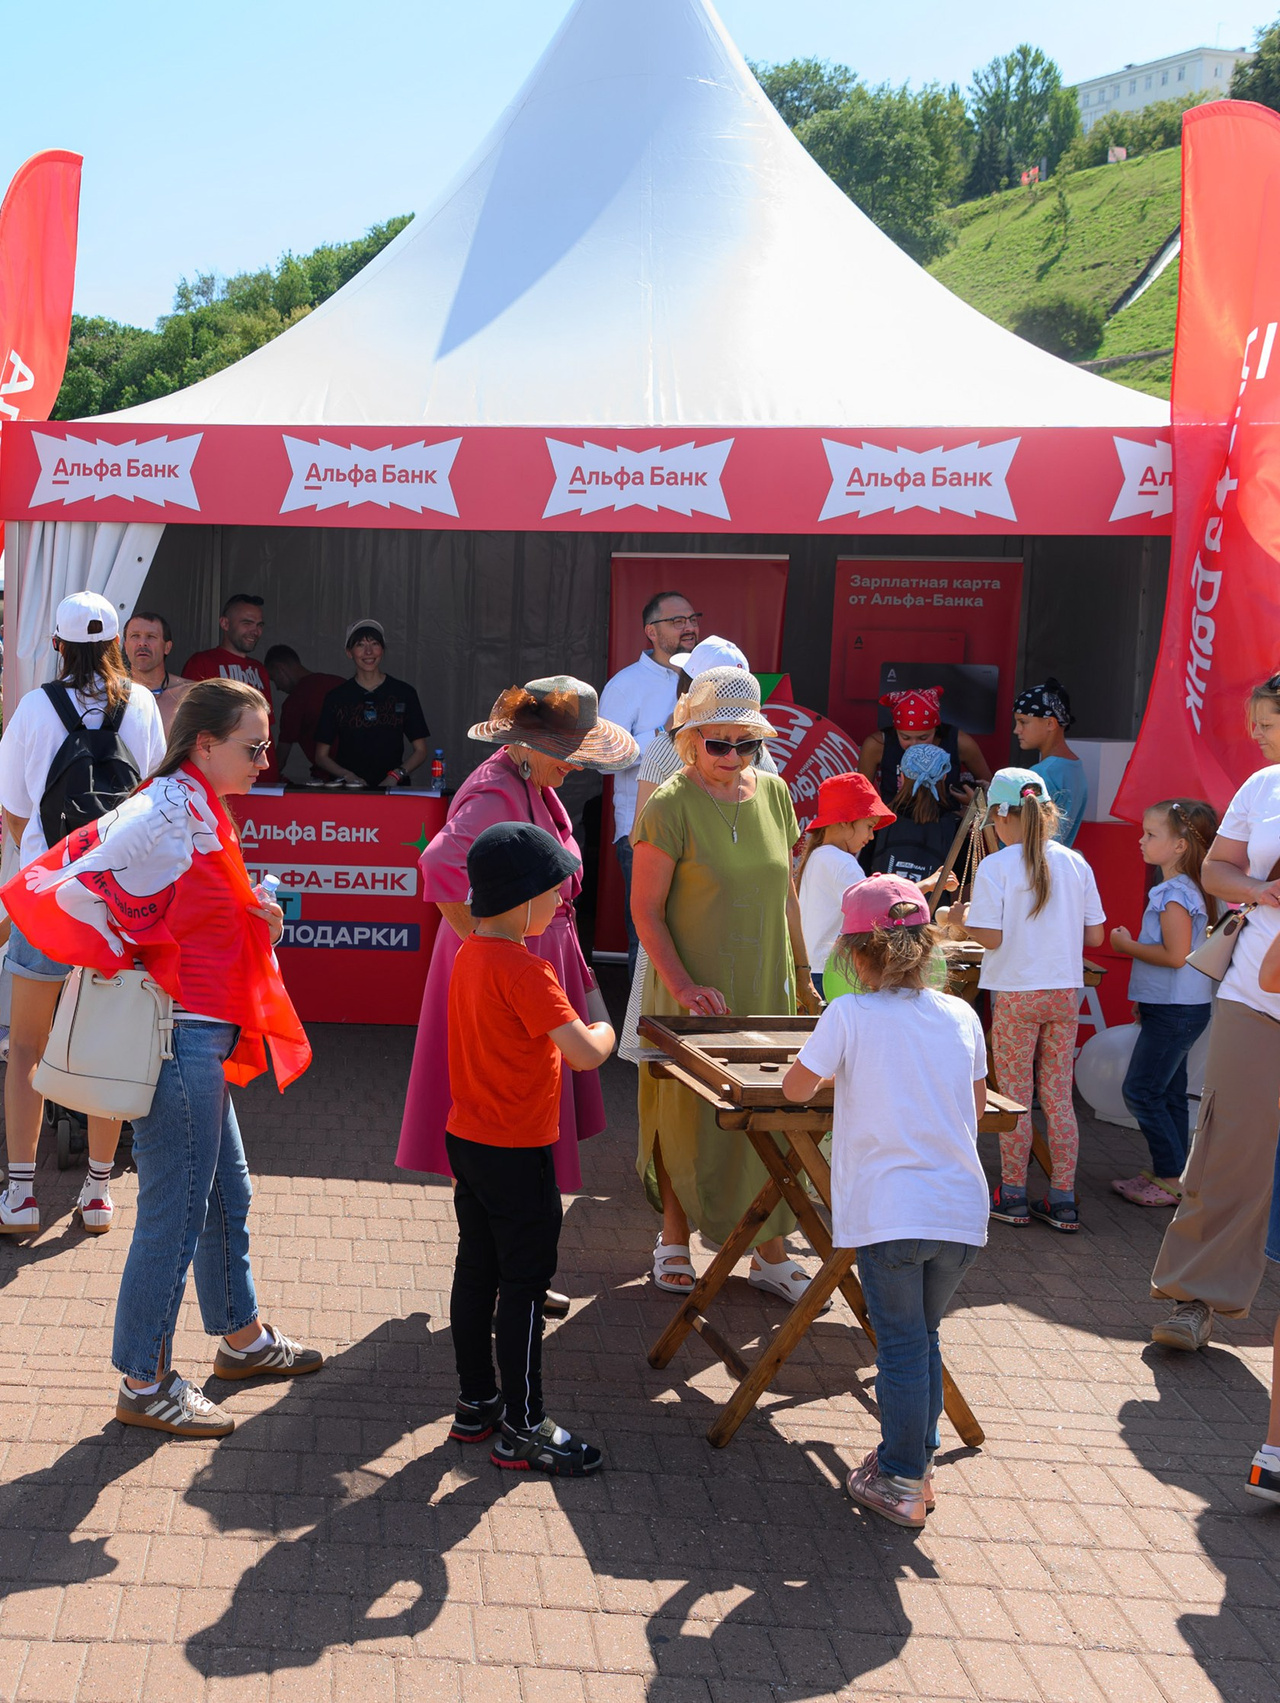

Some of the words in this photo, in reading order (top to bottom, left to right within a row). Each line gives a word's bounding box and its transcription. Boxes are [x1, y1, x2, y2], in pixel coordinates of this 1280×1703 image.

[52, 456, 122, 484] Альфа
[126, 458, 180, 479] Банк
[304, 462, 378, 490] Альфа
[381, 464, 438, 485] Банк
[568, 465, 646, 495] Альфа
[649, 467, 709, 488] Банк
[845, 466, 927, 496] Альфа
[931, 467, 993, 489] Банк
[850, 574, 948, 590] Зарплатная
[952, 578, 1001, 592] карта
[849, 594, 867, 605] от
[870, 593, 984, 608] Альфа-Банка
[240, 818, 316, 848] Альфа
[321, 821, 380, 843] Банк
[92, 871, 112, 898] life
[113, 892, 158, 919] balance
